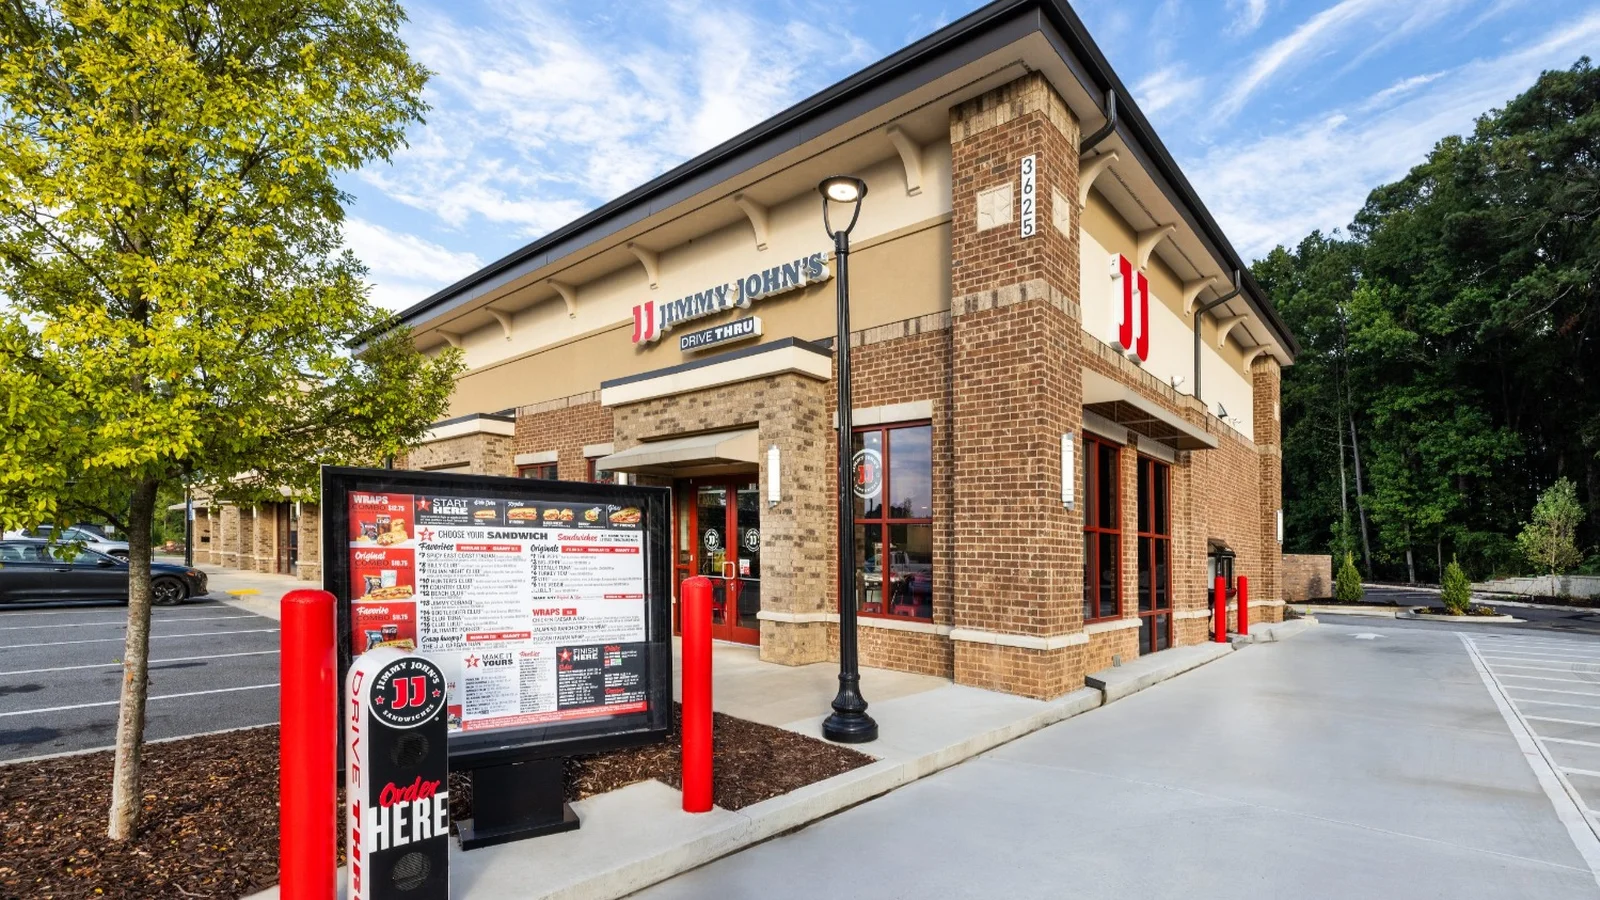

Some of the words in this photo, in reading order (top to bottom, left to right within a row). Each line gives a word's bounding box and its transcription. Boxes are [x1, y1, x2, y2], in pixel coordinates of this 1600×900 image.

[1023, 158, 1033, 236] 3625
[659, 284, 730, 330] JIMMY
[737, 253, 826, 308] JOHN'S
[1113, 253, 1149, 363] JJ
[632, 301, 654, 344] JJ
[681, 329, 712, 350] DRIVE
[715, 320, 753, 340] THRU
[353, 495, 388, 505] WRAPS
[433, 498, 469, 507] START
[433, 507, 469, 515] HERE
[438, 530, 465, 539] CHOOSE
[467, 531, 485, 539] YOUR
[487, 532, 548, 540] SANDWICH
[557, 533, 597, 541] Sandwiches
[419, 543, 454, 552] Favorites
[530, 544, 559, 554] Originals
[355, 552, 386, 563] Original
[356, 606, 389, 616] Favorite
[532, 608, 560, 616] WRAPS
[483, 659, 514, 667] YOURS
[377, 662, 407, 690] JIMMY
[411, 661, 440, 684] JOHN'S
[392, 676, 427, 710] JJ
[383, 704, 434, 722] SANDWICHES
[352, 670, 364, 789] DRIVE
[379, 776, 440, 808] Order
[368, 791, 448, 854] HERE
[353, 800, 361, 900] THR
